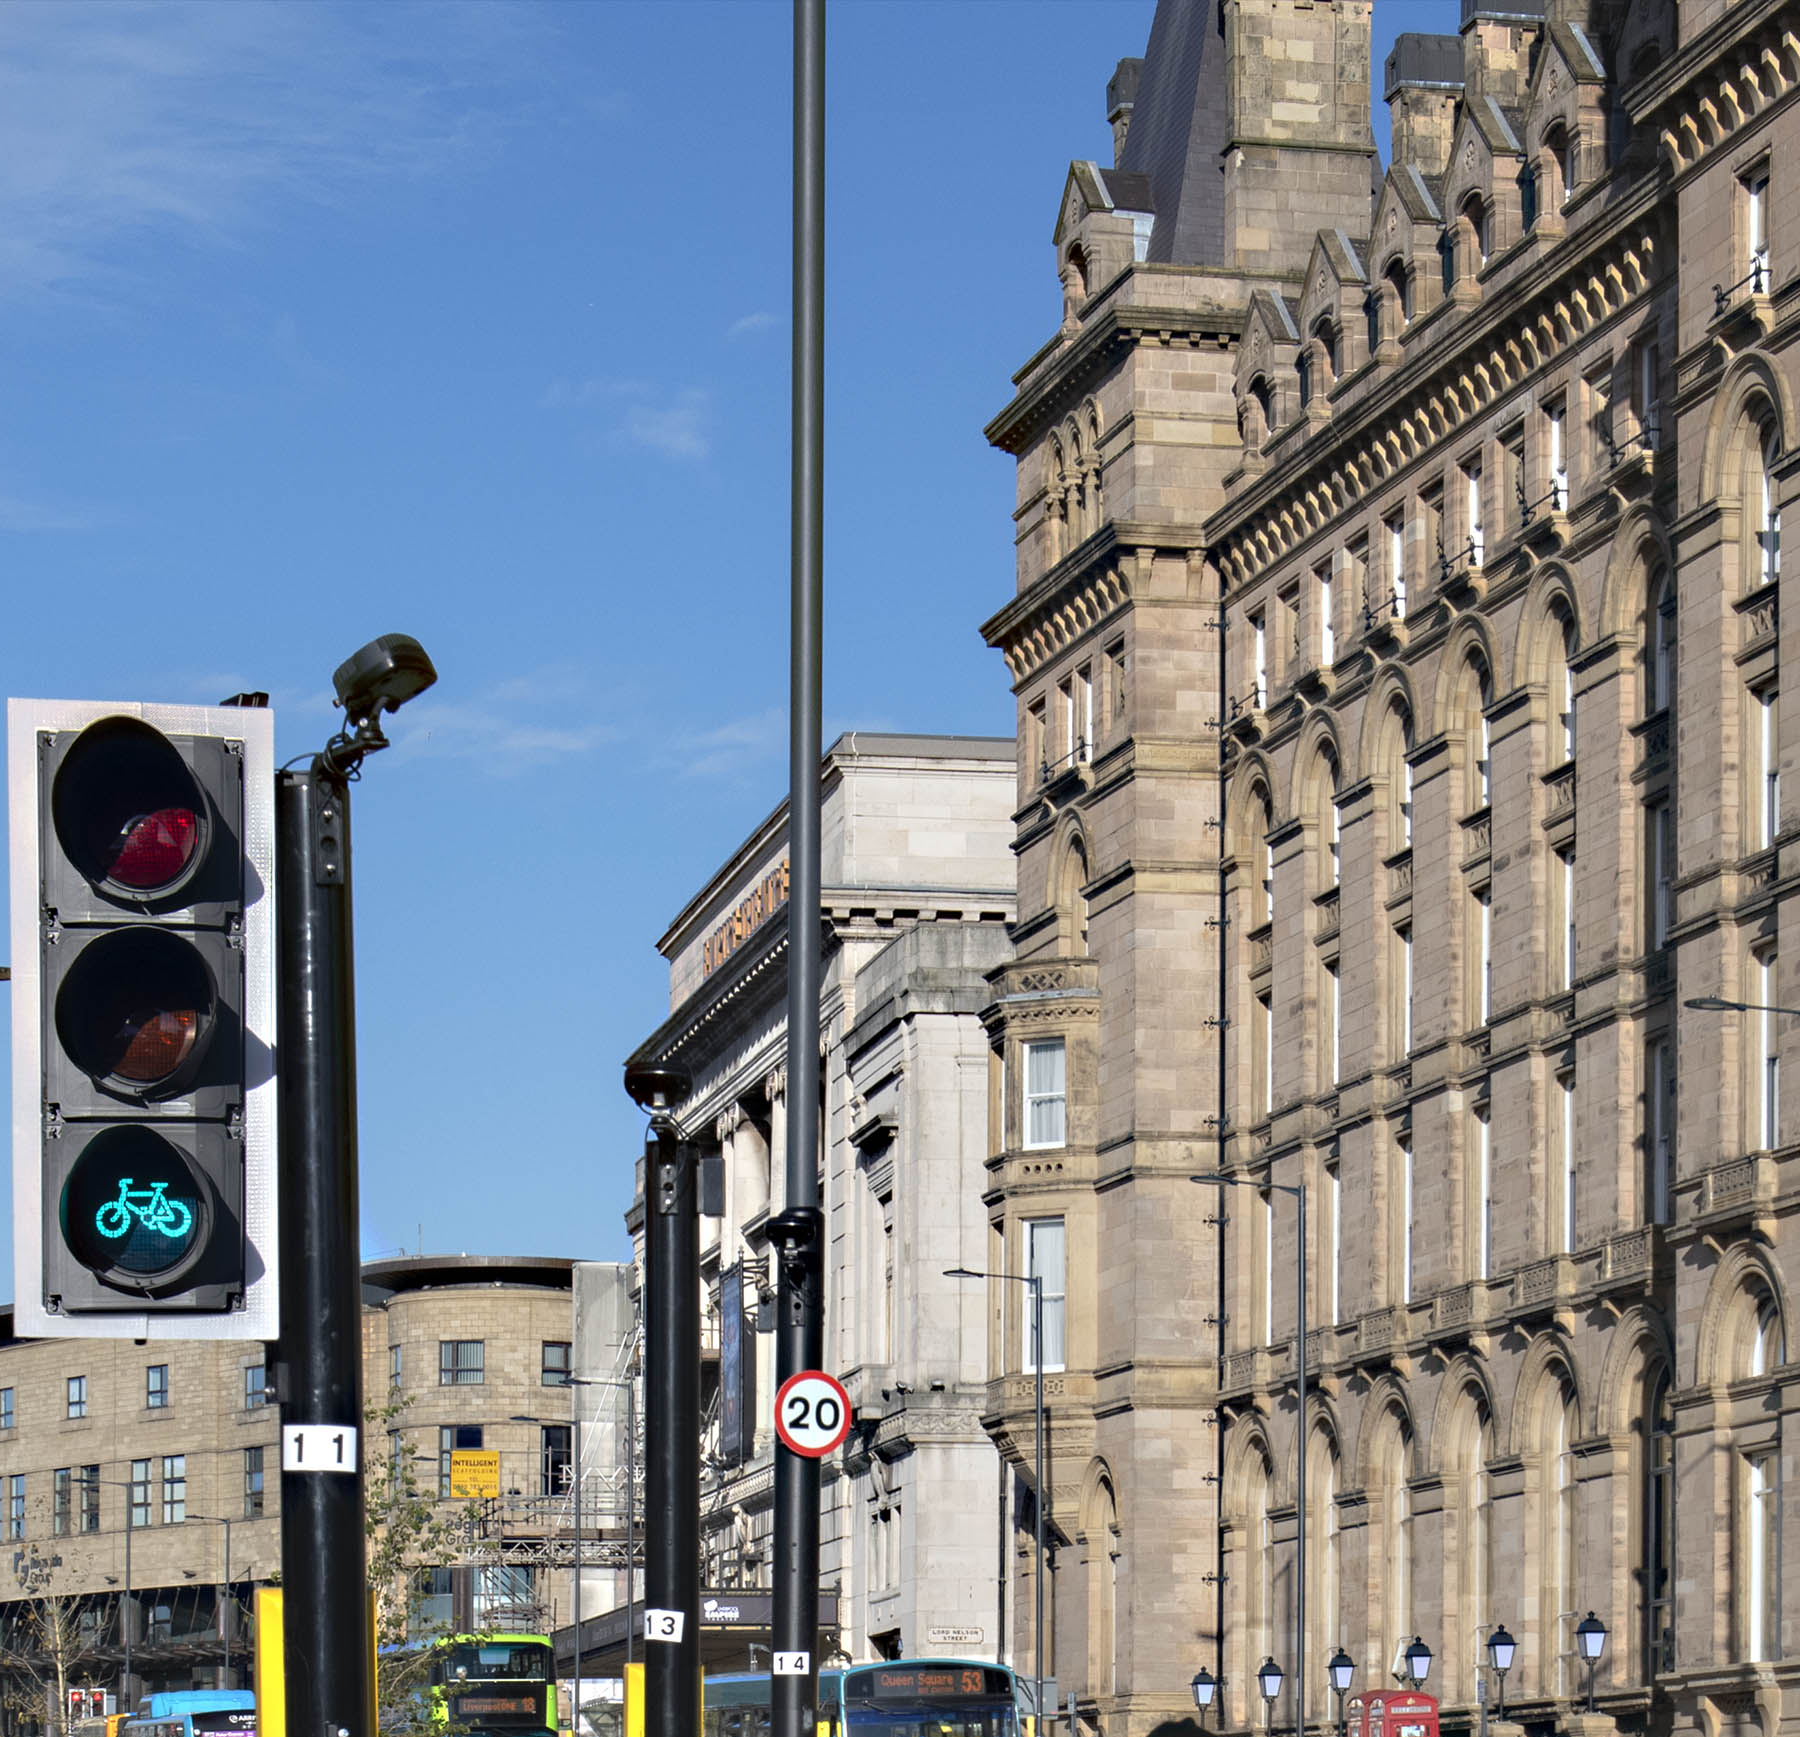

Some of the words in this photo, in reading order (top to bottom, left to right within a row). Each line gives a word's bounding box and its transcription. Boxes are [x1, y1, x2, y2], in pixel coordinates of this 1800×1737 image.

[788, 1396, 840, 1431] 20
[293, 1432, 344, 1463] 11
[452, 1459, 497, 1467] INTELLIGENT
[646, 1614, 676, 1635] 13
[778, 1655, 804, 1671] 14
[880, 1674, 914, 1687] Queen
[917, 1673, 953, 1686] Square
[961, 1671, 983, 1693] 53
